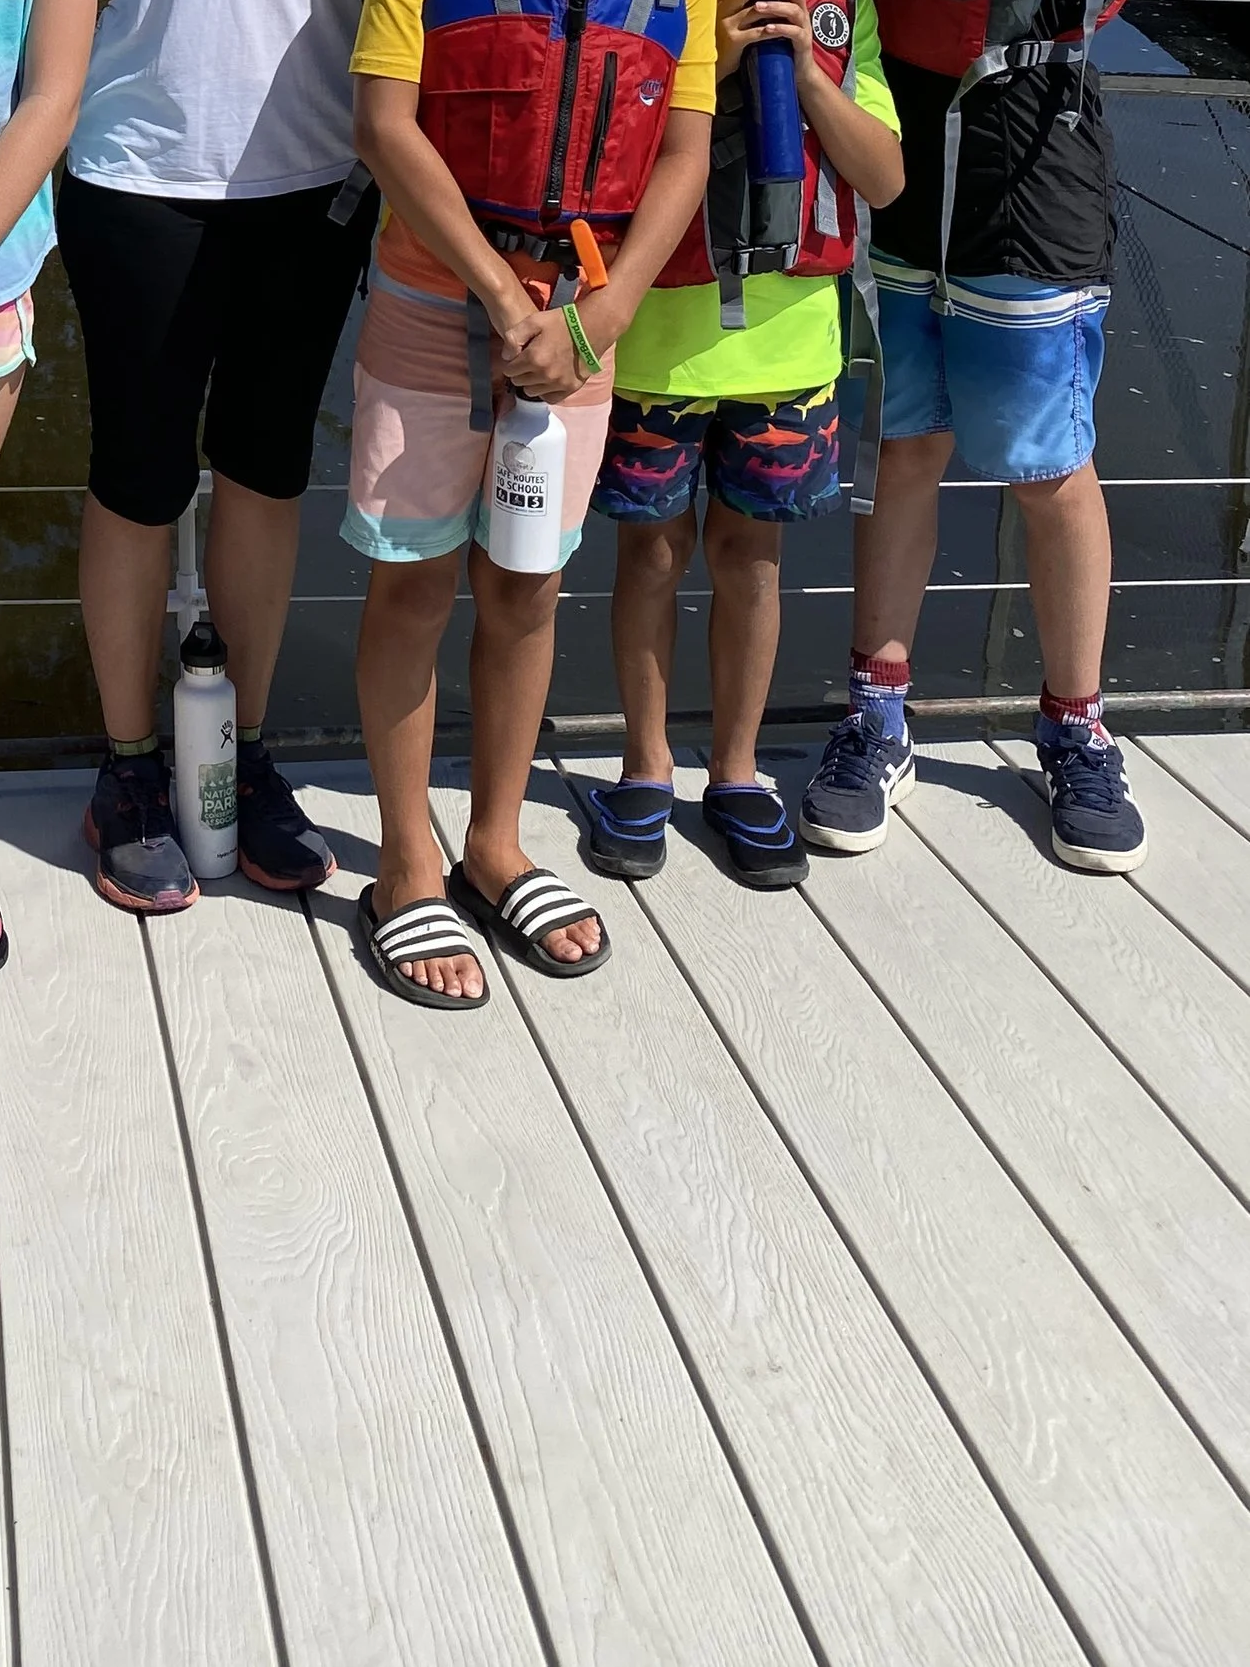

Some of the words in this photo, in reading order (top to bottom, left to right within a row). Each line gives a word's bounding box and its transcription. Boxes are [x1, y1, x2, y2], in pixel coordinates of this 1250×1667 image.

[496, 474, 505, 487] TO
[506, 480, 545, 494] SCHOOL
[513, 474, 545, 484] ROUTES
